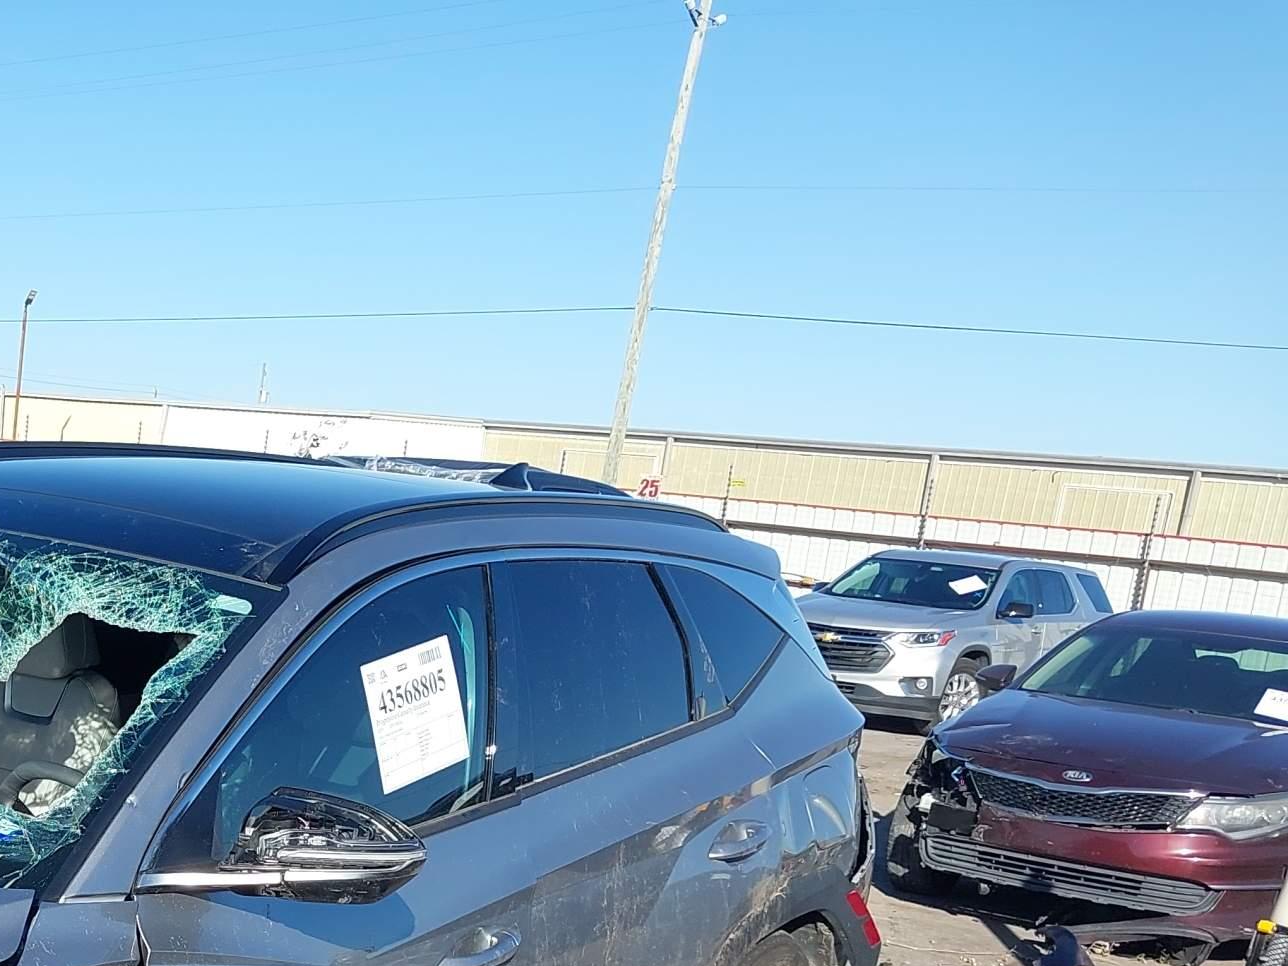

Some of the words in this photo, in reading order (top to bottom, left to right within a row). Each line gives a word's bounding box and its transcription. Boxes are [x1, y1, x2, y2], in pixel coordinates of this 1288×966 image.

[637, 478, 661, 498] 25
[378, 668, 446, 714] 43568805
[1064, 770, 1089, 780] KIA
